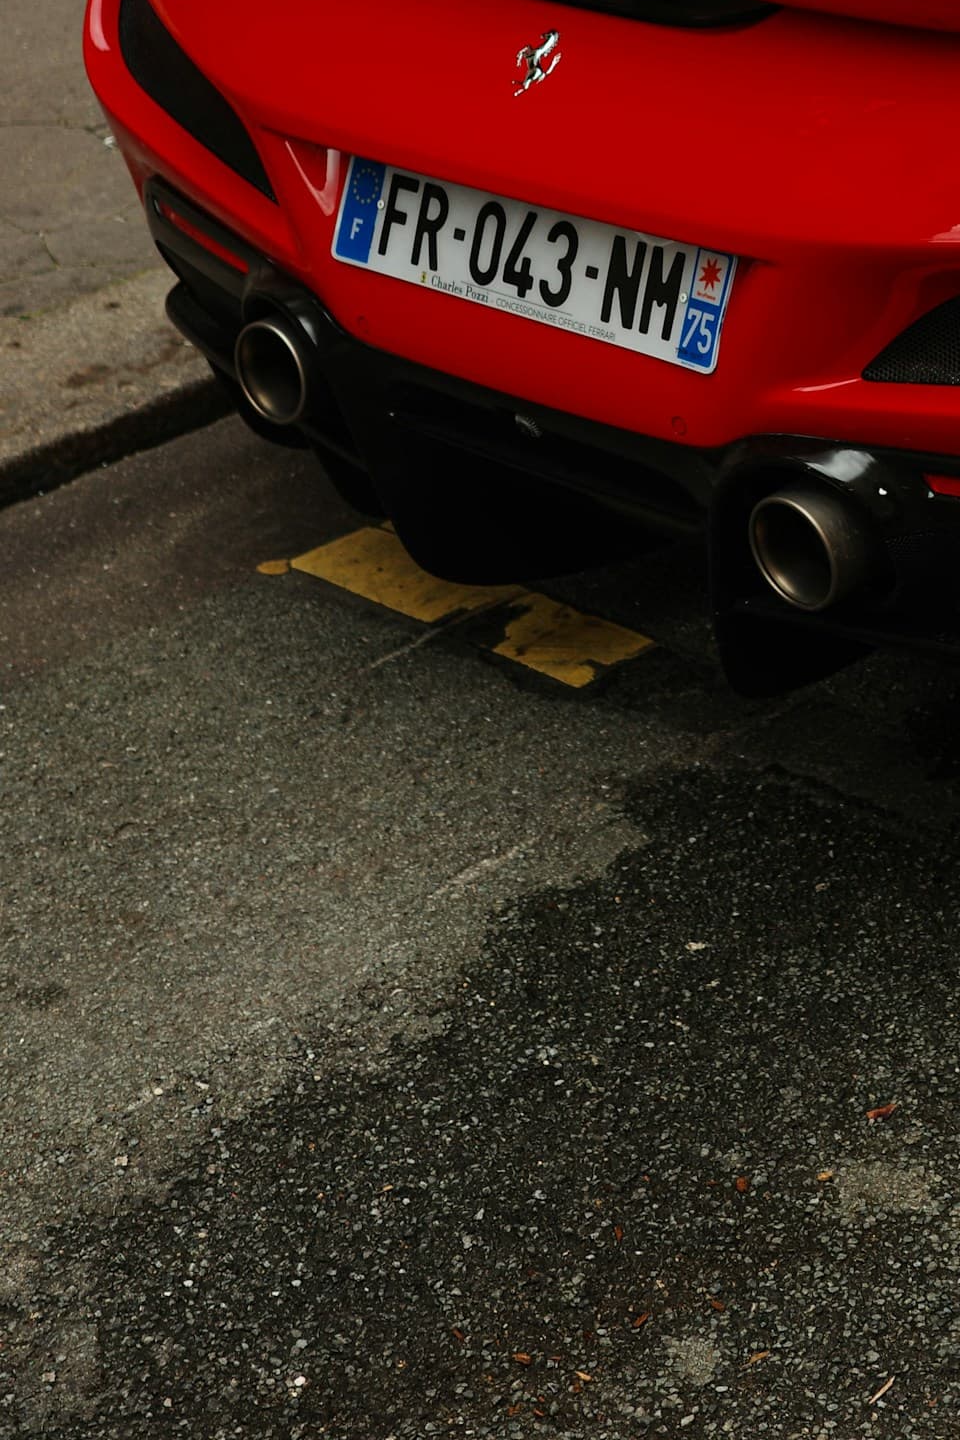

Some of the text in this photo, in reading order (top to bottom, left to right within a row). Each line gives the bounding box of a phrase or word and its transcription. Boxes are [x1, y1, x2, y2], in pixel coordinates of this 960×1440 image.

[349, 217, 364, 240] F
[377, 172, 687, 342] FR-043-NM
[431, 274, 463, 295] Charles
[466, 285, 489, 304] Pozzi
[558, 316, 588, 334] OFFICIEL
[588, 326, 616, 342] FERRARI
[681, 307, 715, 354] 75
